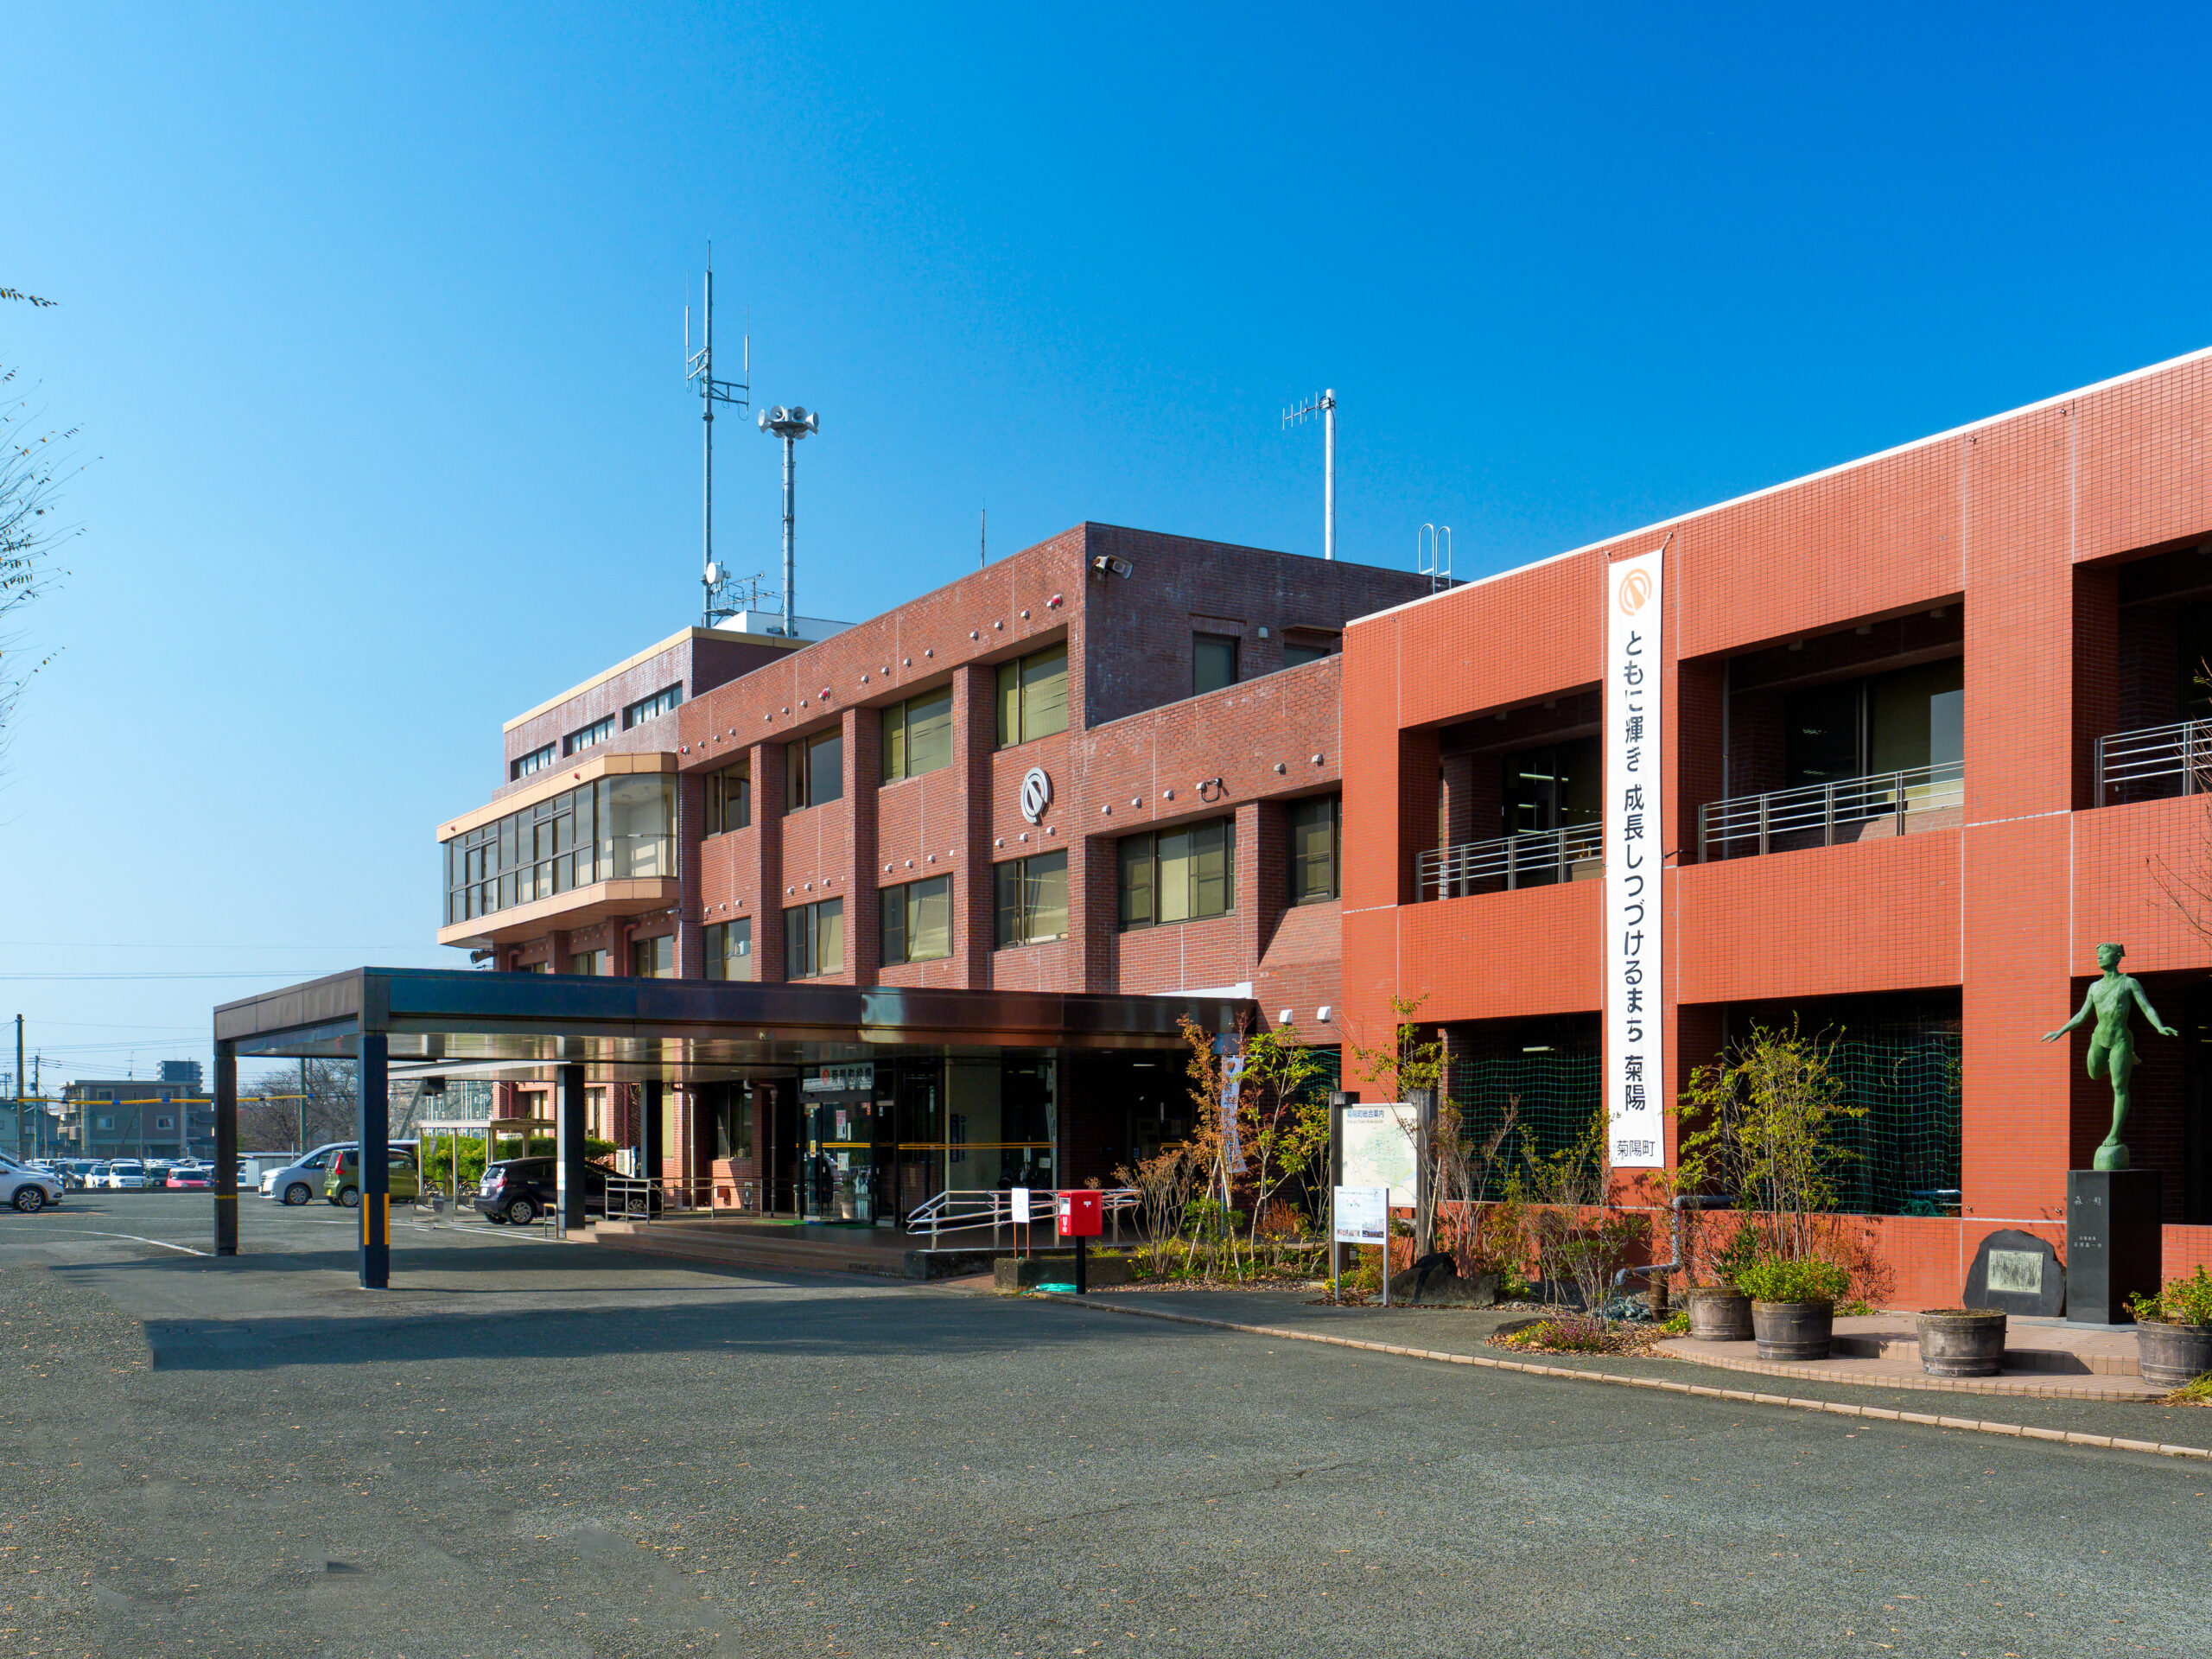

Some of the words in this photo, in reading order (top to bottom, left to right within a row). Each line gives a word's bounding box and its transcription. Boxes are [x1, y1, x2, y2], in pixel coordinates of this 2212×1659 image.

[1623, 630, 1644, 773] ともに輝き
[1623, 784, 1645, 1043] 成長しつづけるまち
[1624, 1055, 1646, 1111] 菊陽
[1617, 1140, 1656, 1157] 菊陽町
